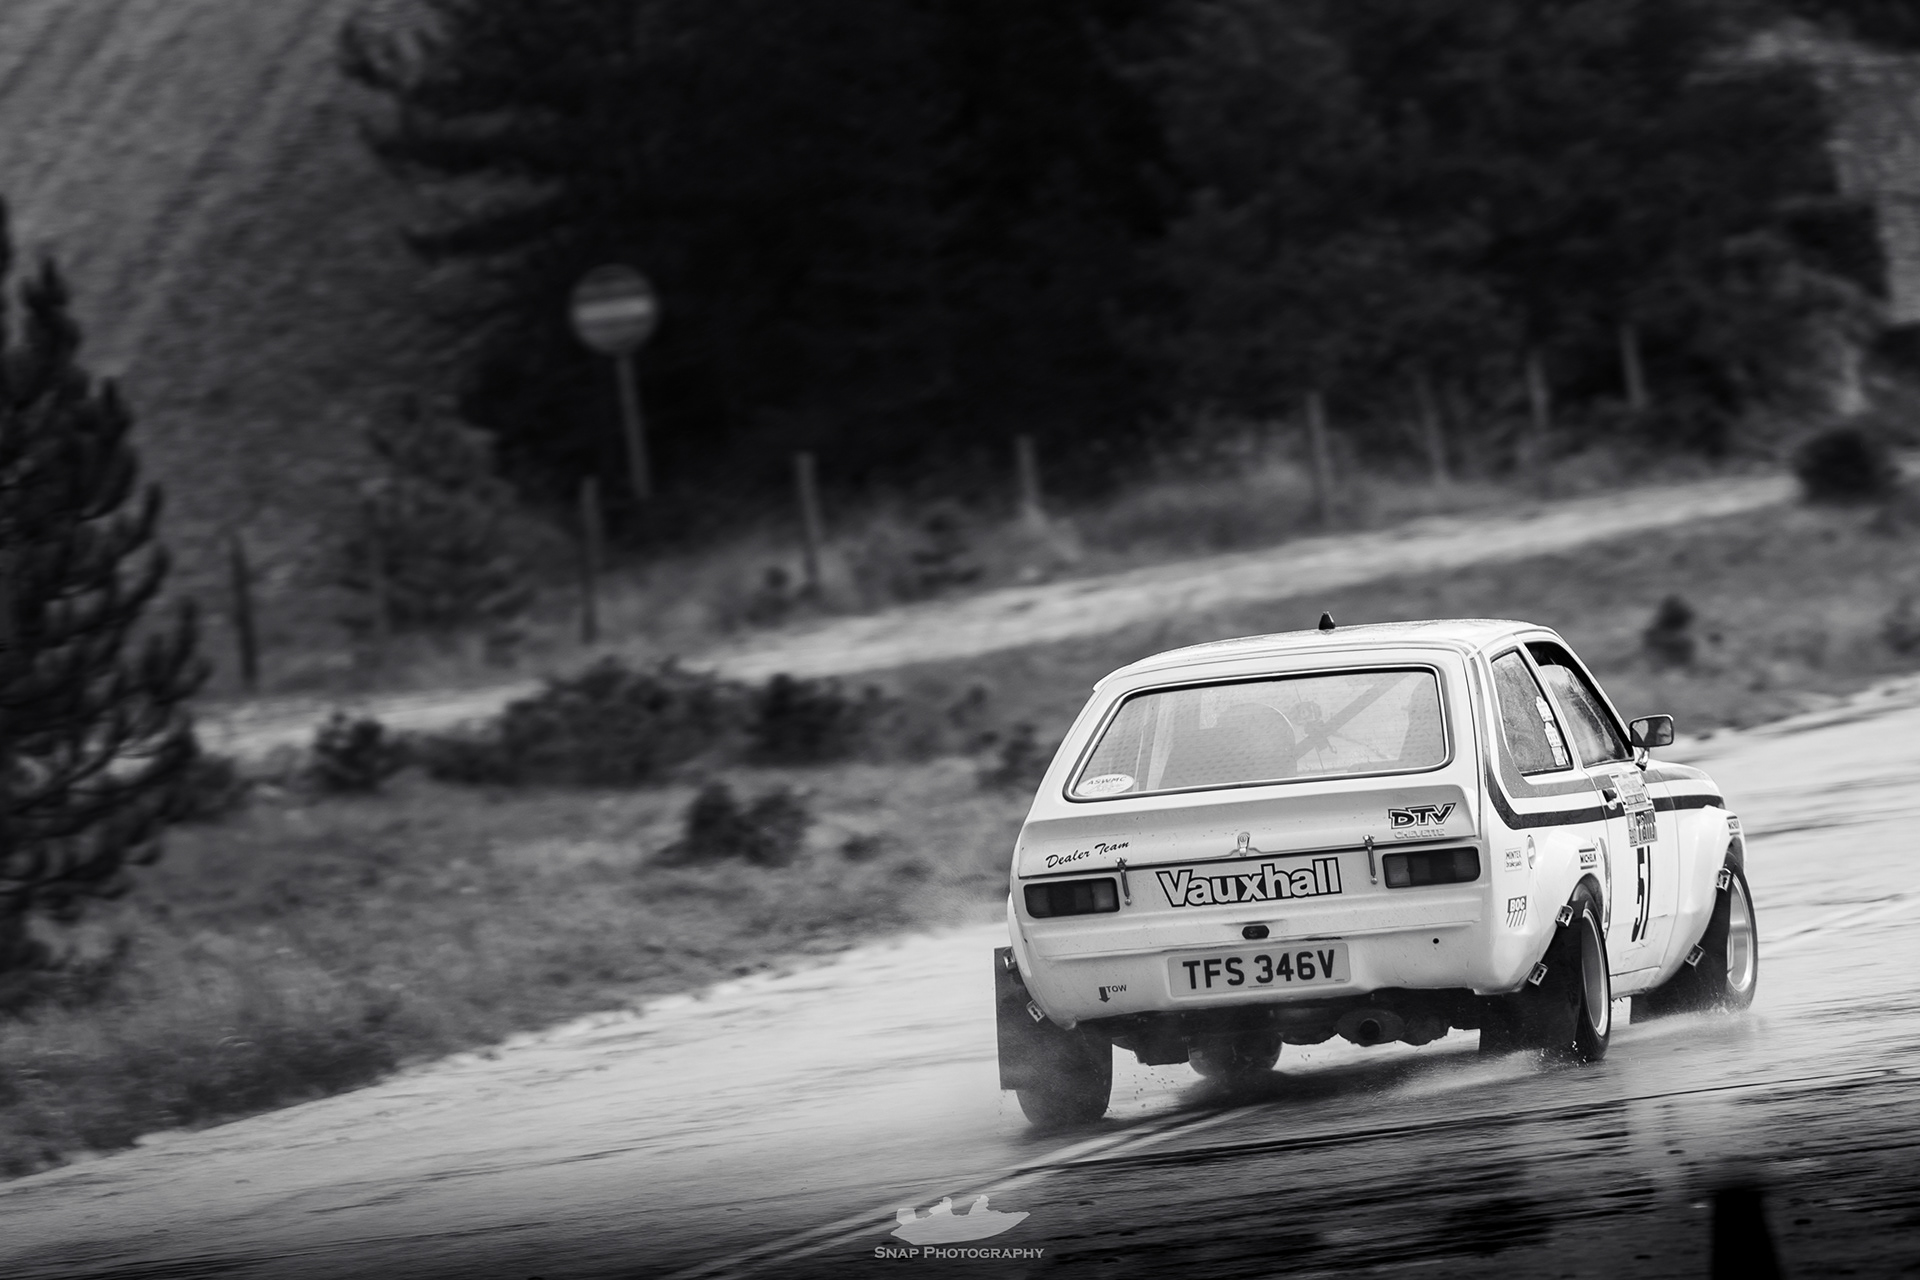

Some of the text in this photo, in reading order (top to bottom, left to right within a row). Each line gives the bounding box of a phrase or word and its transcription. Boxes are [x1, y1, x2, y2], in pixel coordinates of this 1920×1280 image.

[1388, 802, 1456, 829] DTV
[1045, 841, 1130, 869] Dealer Team
[1155, 857, 1342, 907] Vauxhall
[1510, 897, 1525, 911] BOC
[1182, 949, 1335, 989] TFS 346V
[1107, 984, 1127, 993] TOW
